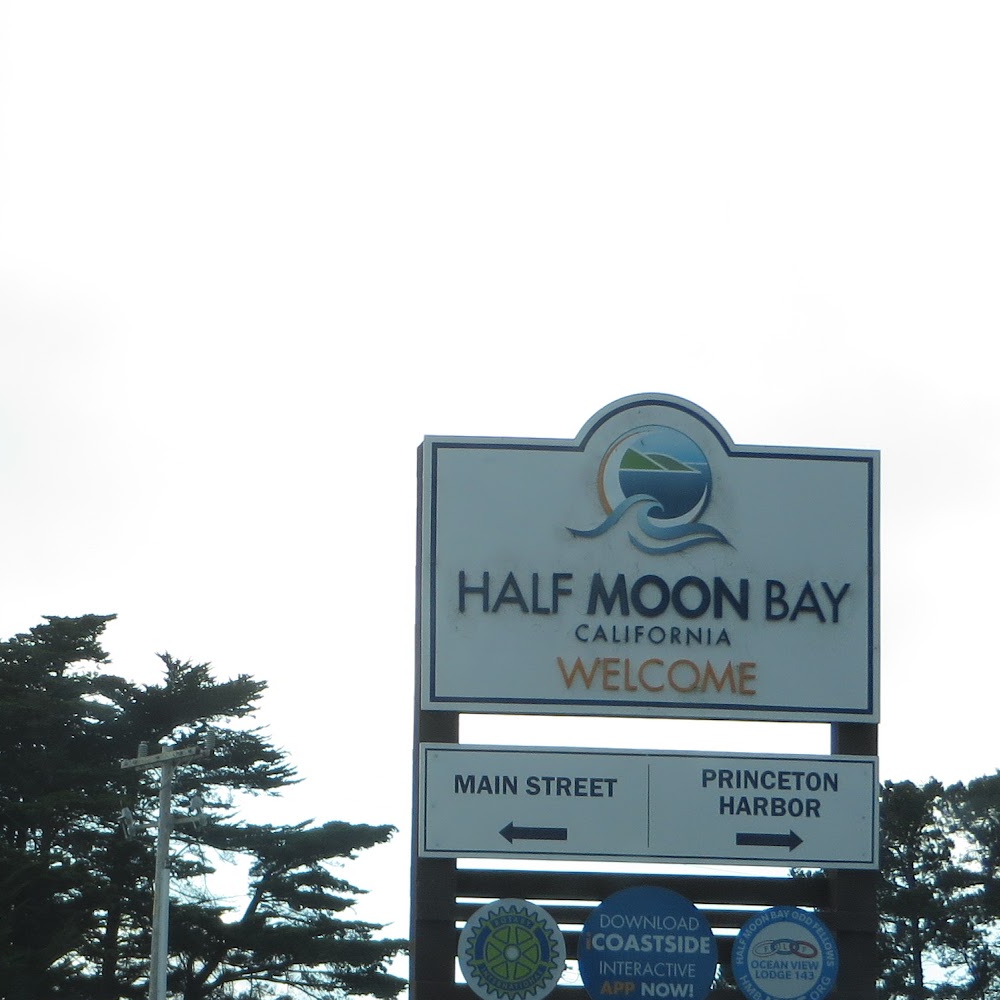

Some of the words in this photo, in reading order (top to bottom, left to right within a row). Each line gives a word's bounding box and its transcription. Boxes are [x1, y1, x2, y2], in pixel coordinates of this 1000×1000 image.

[458, 570, 573, 615] HALF
[587, 573, 748, 620] MOON
[765, 579, 851, 623] BAY
[574, 624, 731, 646] CALIFORNIA
[557, 656, 756, 695] WELCOME
[454, 774, 518, 795] MAIN
[525, 776, 617, 797] STREET
[702, 769, 838, 792] PRINCETON
[719, 796, 821, 818] HARBOR
[600, 914, 700, 931] DOWNLOAD
[736, 938, 746, 965] HALF
[743, 914, 769, 938] MOON
[771, 910, 790, 919] BAY
[792, 910, 812, 925] ODD
[812, 923, 835, 967] FELLOWS
[600, 961, 696, 978] INTERACTIVE
[751, 960, 788, 970] OCEAN
[790, 960, 819, 970] VIEW
[756, 970, 792, 980] LODGE
[795, 971, 814, 980] 143
[600, 981, 635, 995] APP
[641, 982, 694, 998] NOW!
